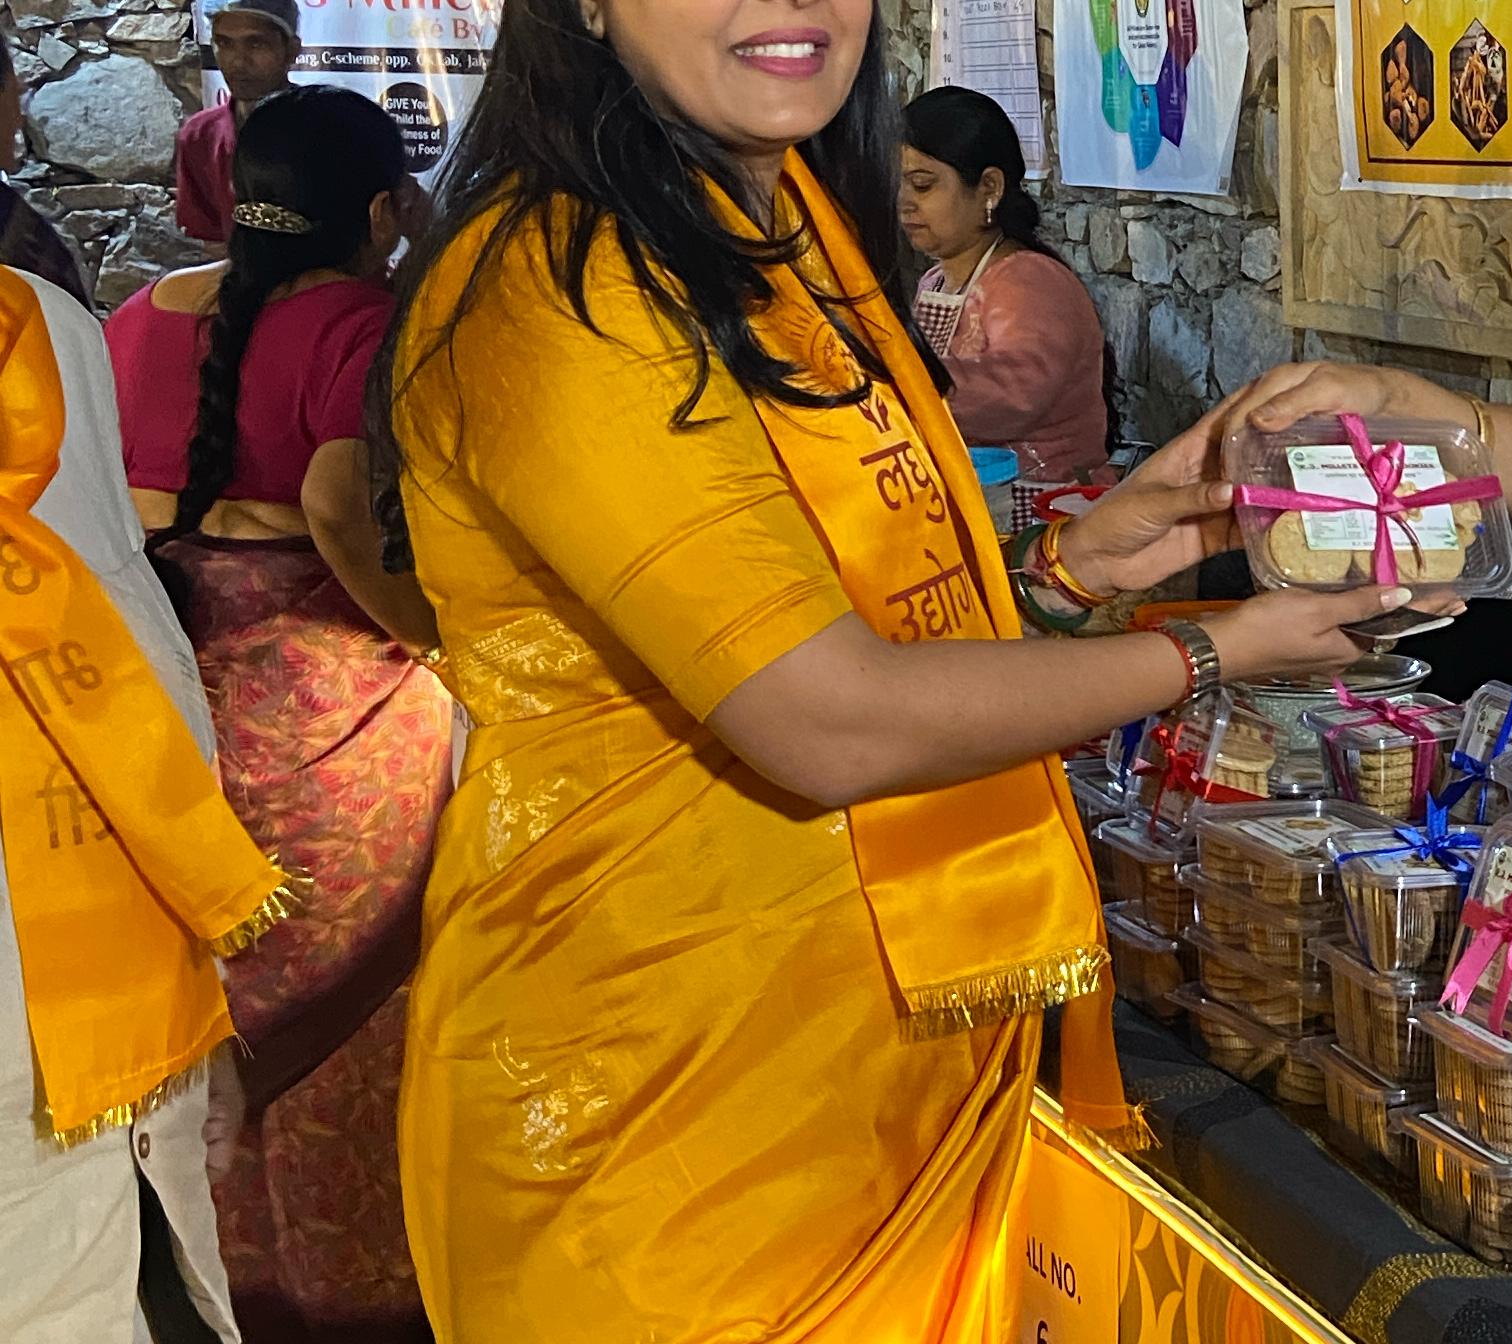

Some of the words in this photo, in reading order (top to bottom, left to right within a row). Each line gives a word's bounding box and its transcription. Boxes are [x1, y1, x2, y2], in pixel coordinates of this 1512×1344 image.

[385, 53, 411, 69] opp.
[386, 98, 409, 110] GIVE
[416, 113, 431, 125] the
[431, 129, 440, 140] of
[860, 440, 948, 524] लघु
[1051, 1250, 1082, 1305] NO.
